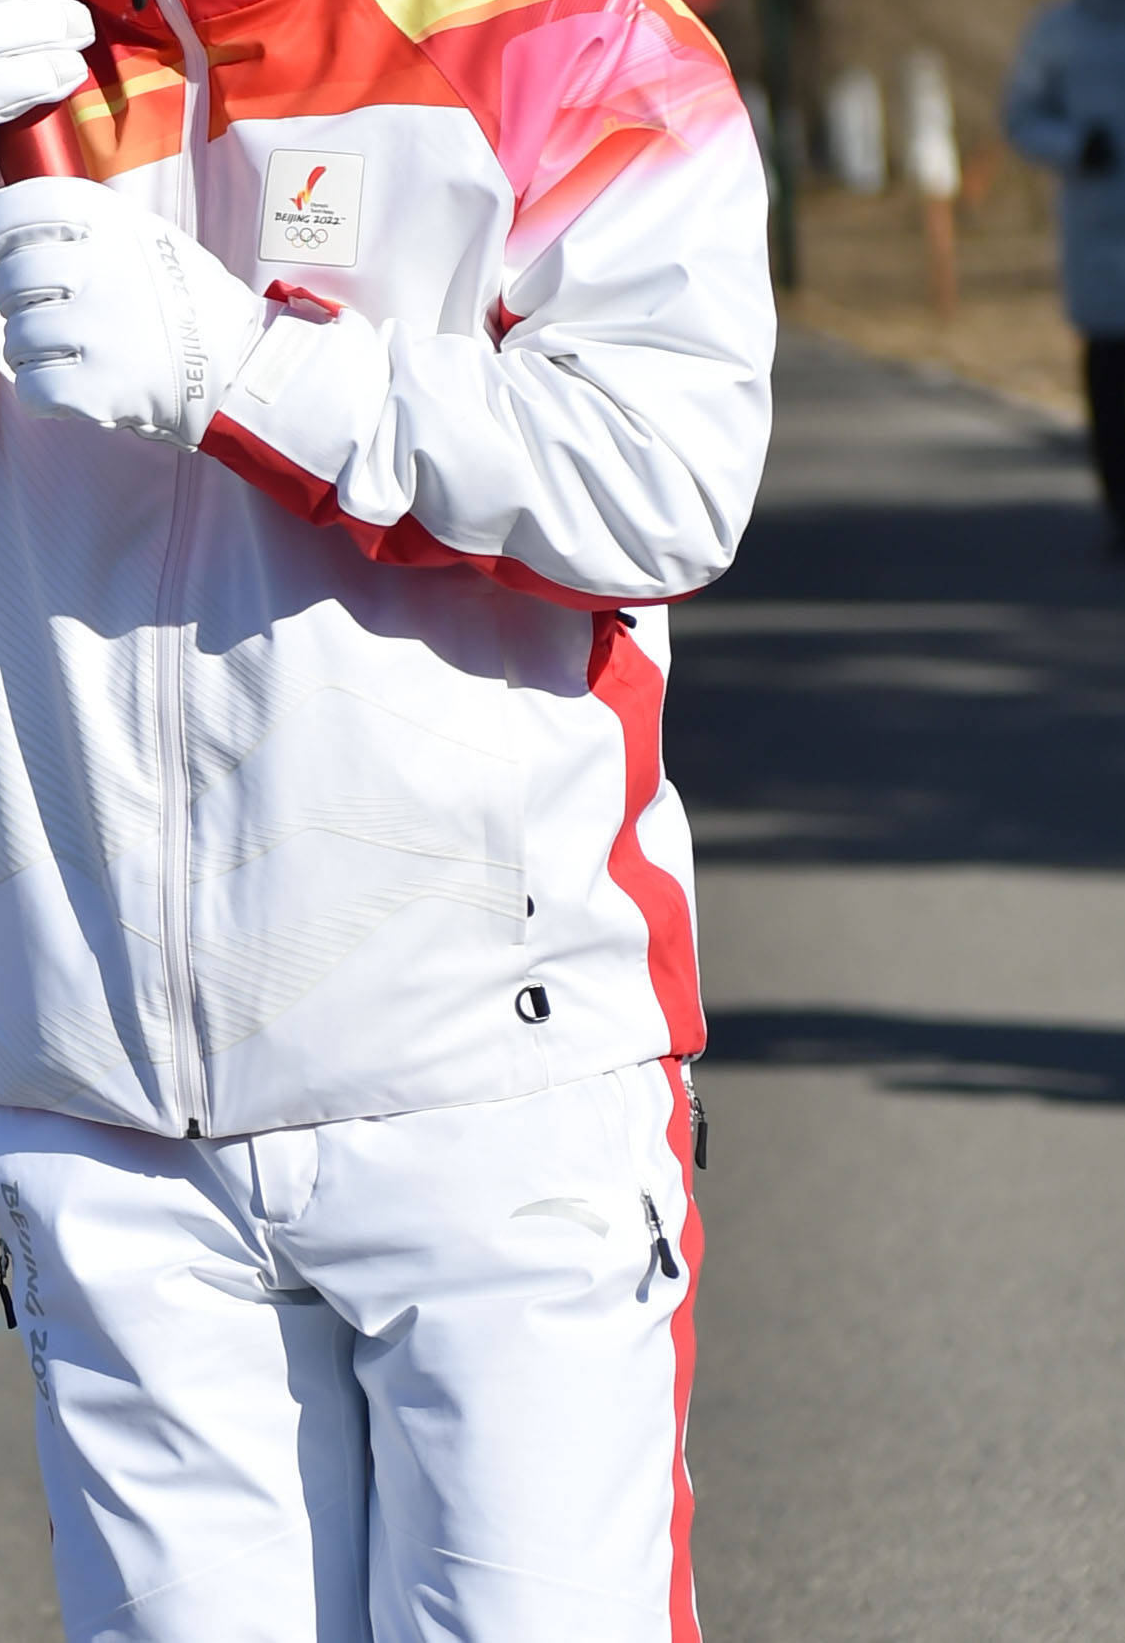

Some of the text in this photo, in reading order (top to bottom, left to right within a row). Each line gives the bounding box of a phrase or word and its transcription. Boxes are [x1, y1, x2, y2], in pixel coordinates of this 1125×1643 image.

[274, 211, 311, 225] BEIJING
[313, 215, 342, 226] 2022
[180, 305, 209, 403] BEIJING
[1, 1180, 45, 1318] BEIJING
